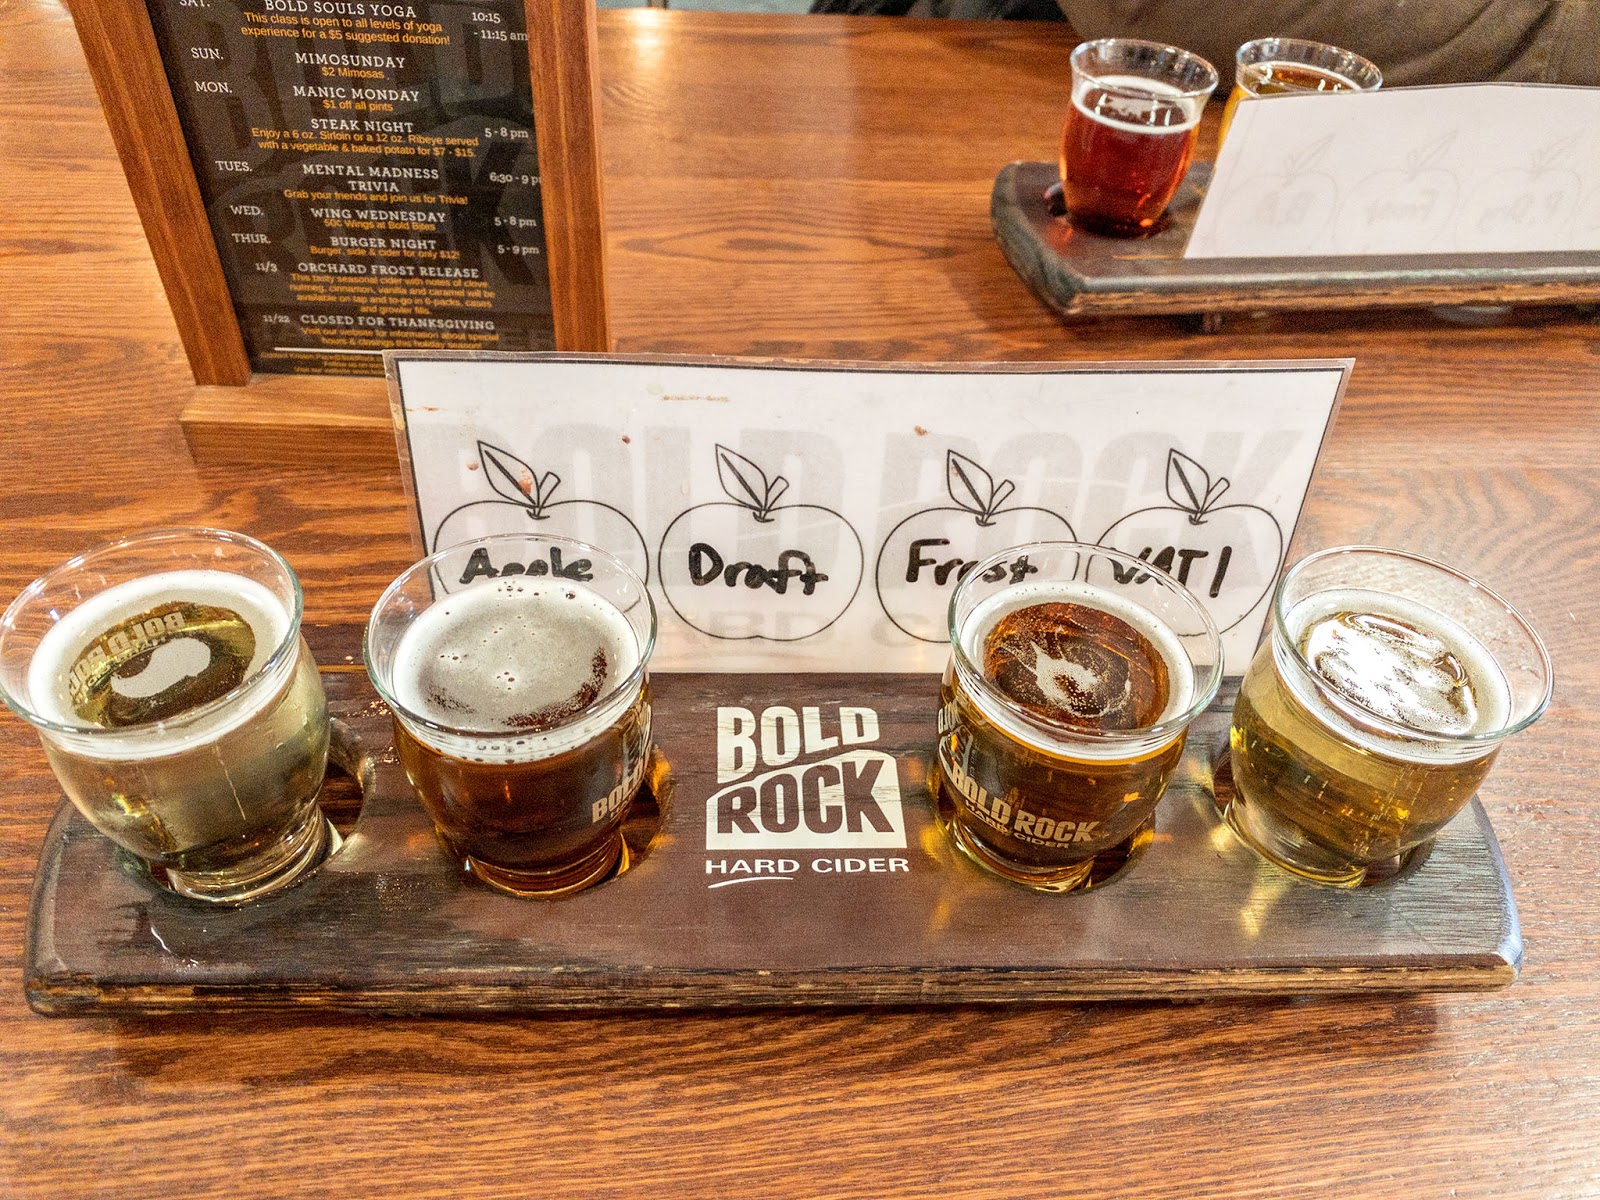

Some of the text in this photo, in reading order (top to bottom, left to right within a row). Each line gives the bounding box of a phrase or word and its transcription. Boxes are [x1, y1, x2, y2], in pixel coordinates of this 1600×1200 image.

[264, 0, 417, 18] BOLD SOULS YOGA
[244, 12, 443, 34] This class is open to all levels of yoga
[472, 12, 501, 24] 10:15
[241, 26, 451, 45] experience for a $5 suggested donation!
[481, 29, 529, 42] 11:15 am
[190, 47, 224, 60] SUN.
[294, 52, 406, 69] MIMOSUNDAY
[321, 66, 385, 79] $2 Mimosas
[194, 80, 233, 94] MON.
[293, 85, 420, 102] MANIC MONDAY
[323, 99, 394, 113] $1 off all pints
[310, 118, 414, 133] STEAK NIGHT
[251, 127, 280, 139] Enjoy
[283, 130, 291, 139] a
[292, 128, 300, 139] 6
[301, 131, 317, 140] oz.
[320, 129, 351, 141] Sirloin
[353, 132, 364, 142] or
[366, 133, 374, 142] a
[376, 132, 387, 143] 12
[408, 134, 443, 146] Ribeye
[445, 136, 479, 147] served
[484, 127, 529, 140] 5 8 pm
[258, 140, 279, 150] with
[281, 142, 289, 150] a
[291, 141, 339, 152] vegetable
[341, 143, 349, 153] &
[351, 144, 382, 154] baked
[384, 145, 415, 156] potato
[417, 146, 431, 156] for
[433, 146, 446, 157] $7
[215, 160, 253, 172] TUES.
[302, 164, 440, 179] MENTAL MADNESS
[489, 171, 513, 183] 6:30
[521, 175, 529, 185] 9
[348, 181, 400, 193] TRIVIA
[283, 189, 469, 205] Grab your friends and join us for Trivia!
[230, 205, 265, 216] WED.
[310, 207, 446, 223] WING WEDNESDAY
[345, 219, 375, 230] Wings
[376, 221, 386, 229] at
[388, 220, 409, 230] Bold
[411, 222, 437, 232] Bites
[494, 216, 537, 228] 5 8 pm
[231, 232, 271, 244] THUR.
[330, 236, 437, 250] BURGER NIGHT
[347, 246, 367, 256] side
[378, 248, 401, 257] cider
[403, 248, 416, 258] for
[418, 249, 438, 260] only
[498, 244, 540, 256] 5 9 pm
[255, 260, 278, 273] 11/3
[298, 262, 480, 279] ORCHARD FROST RELEASE
[300, 314, 496, 331] CLOSED FOR THANKSGIVING
[688, 542, 829, 595] Draft
[716, 706, 879, 784] BOLD
[717, 758, 894, 833] ROCK
[952, 761, 1101, 843] BOLD ROCK
[965, 799, 1070, 849] HARD CIDER
[706, 857, 909, 875] HARD CIDER
